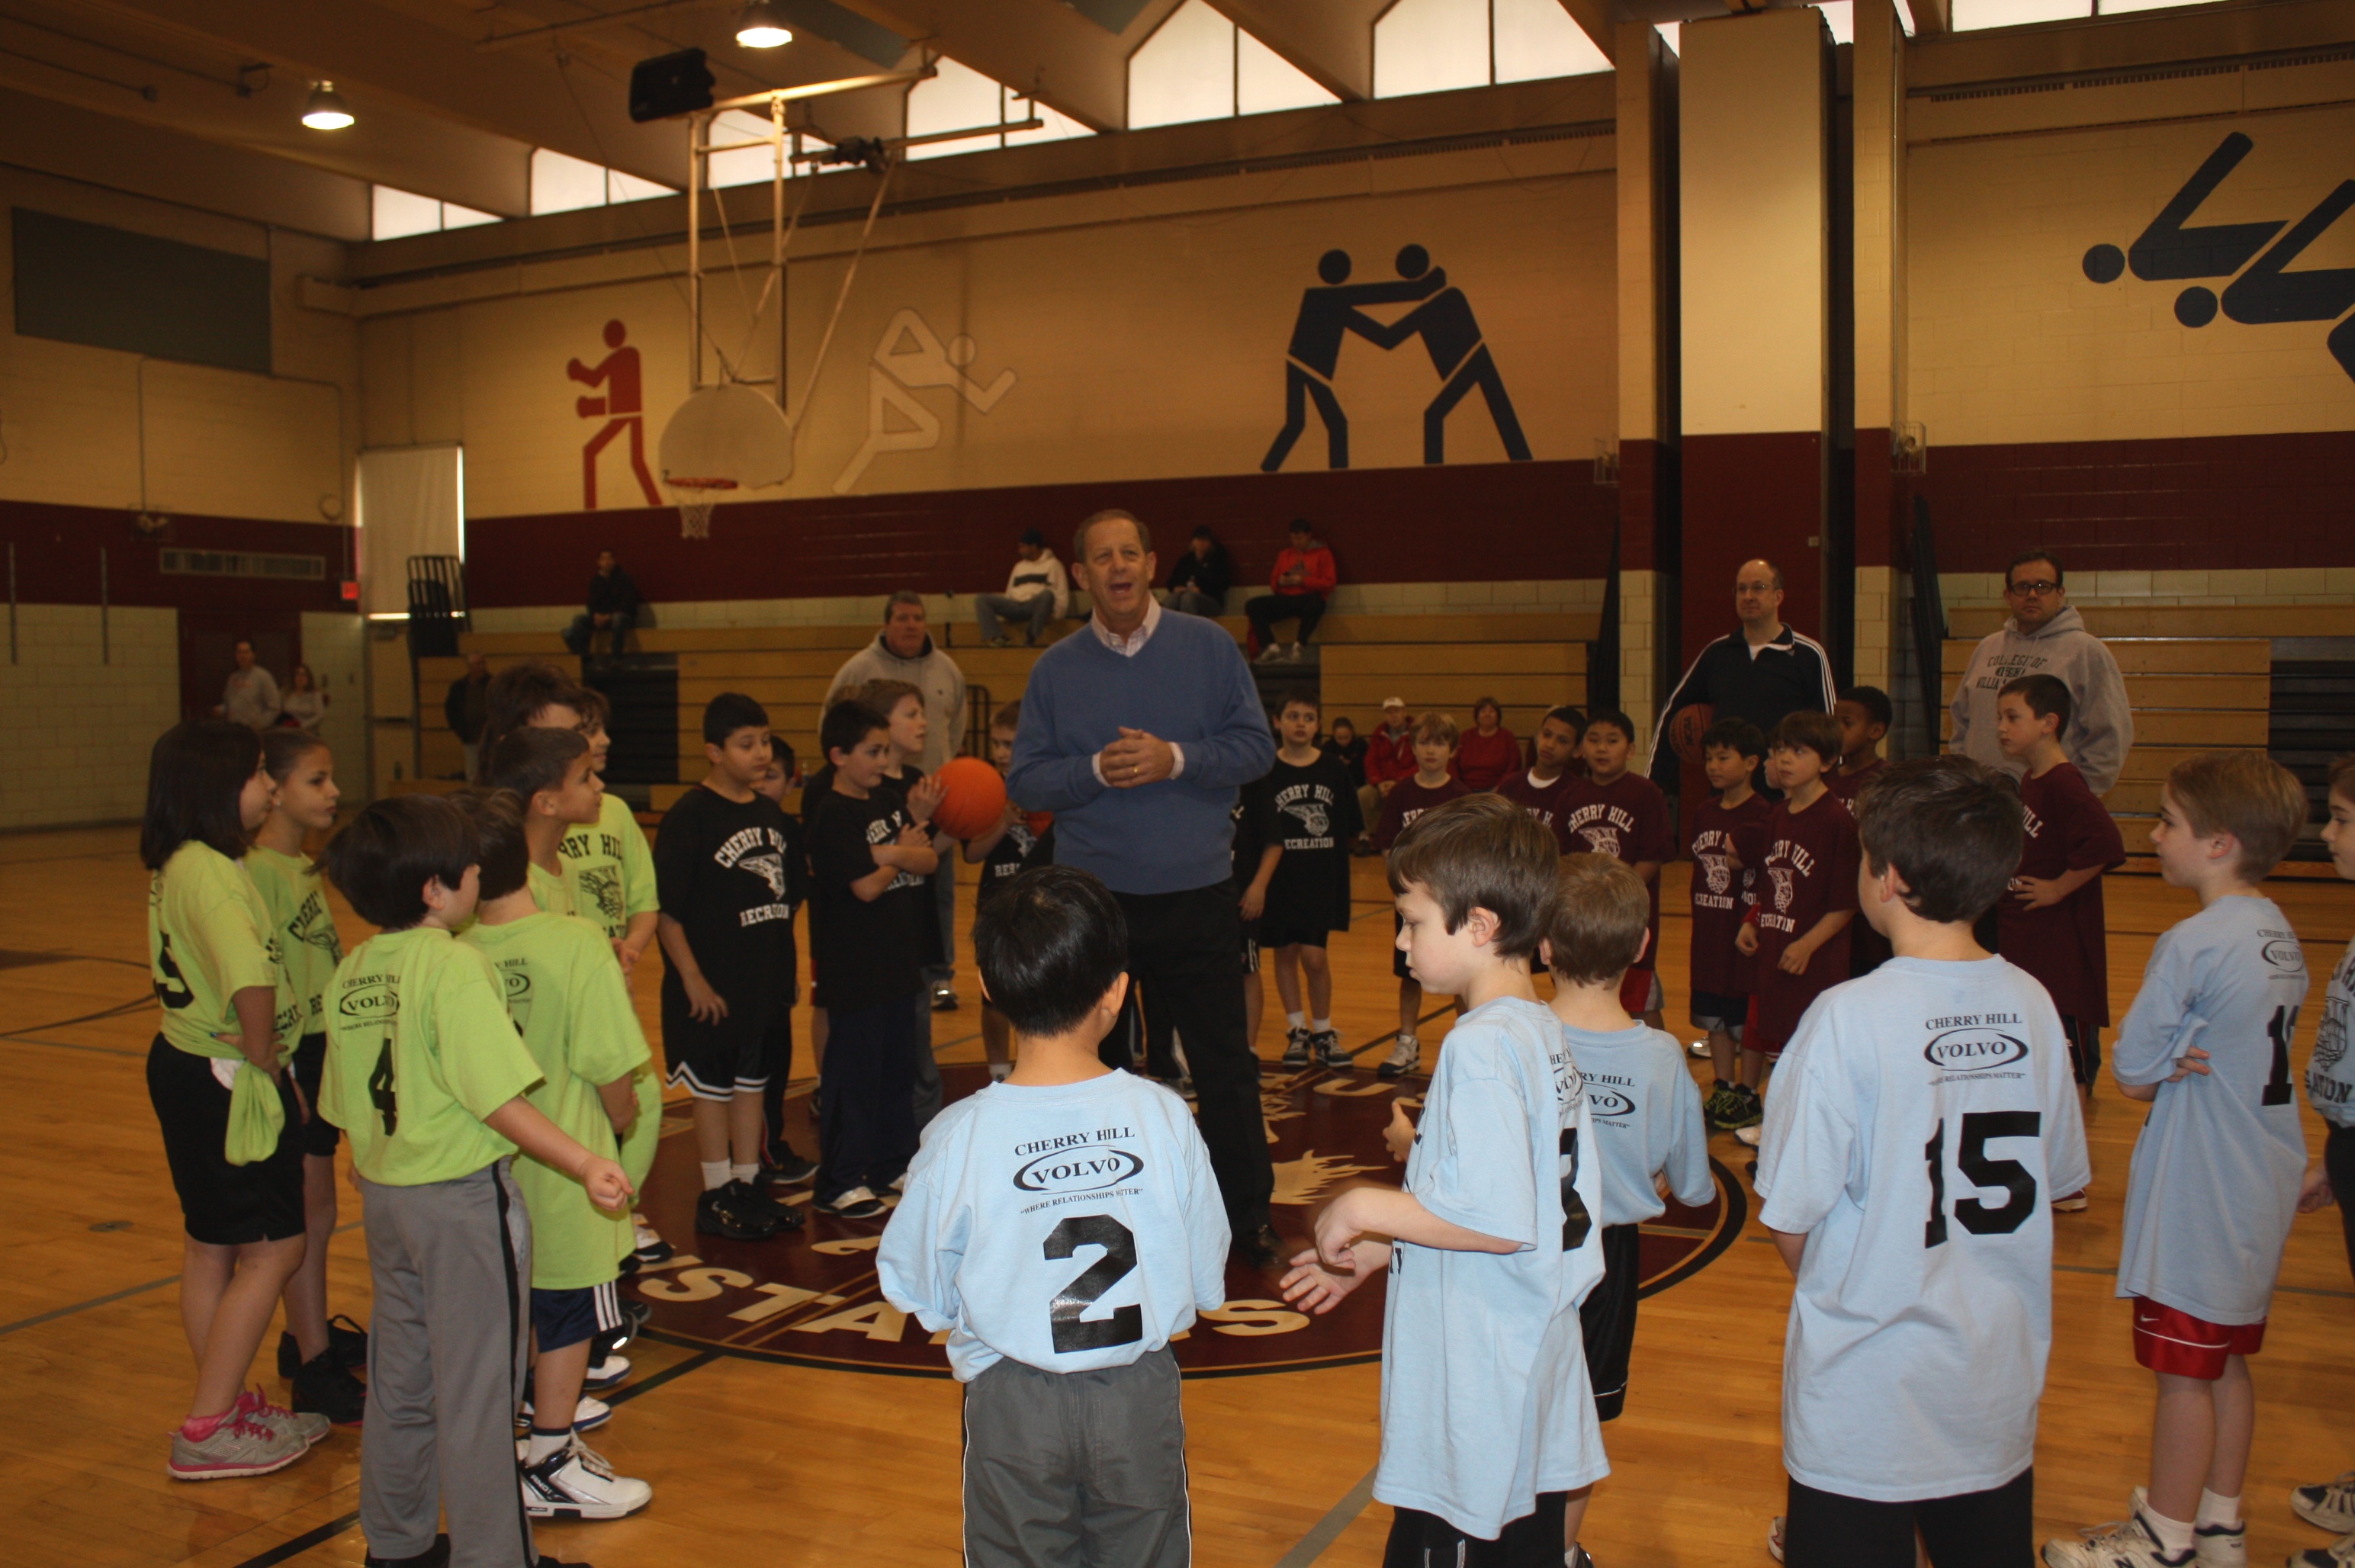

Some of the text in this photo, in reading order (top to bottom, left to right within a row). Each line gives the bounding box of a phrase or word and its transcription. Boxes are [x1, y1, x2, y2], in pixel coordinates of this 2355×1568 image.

[1275, 784, 1309, 812] HERRY
[1608, 806, 1634, 833] HILL
[558, 834, 590, 859] RRY
[714, 827, 763, 869] CHERRY
[1284, 837, 1334, 850] ECREATION
[1791, 843, 1814, 877] HILL
[1926, 1013, 2022, 1030] CHERRY HILL
[1937, 1042, 2006, 1059] VOLVO
[368, 1037, 397, 1136] 4
[1602, 1075, 1635, 1087] HILL
[1015, 1126, 1136, 1156] CHERRY HILL
[1032, 1158, 1120, 1184] VOLVO
[1926, 1110, 2041, 1249] 15
[1052, 1190, 1114, 1207] RELATIONSHIPS
[1043, 1214, 1142, 1354] 2
